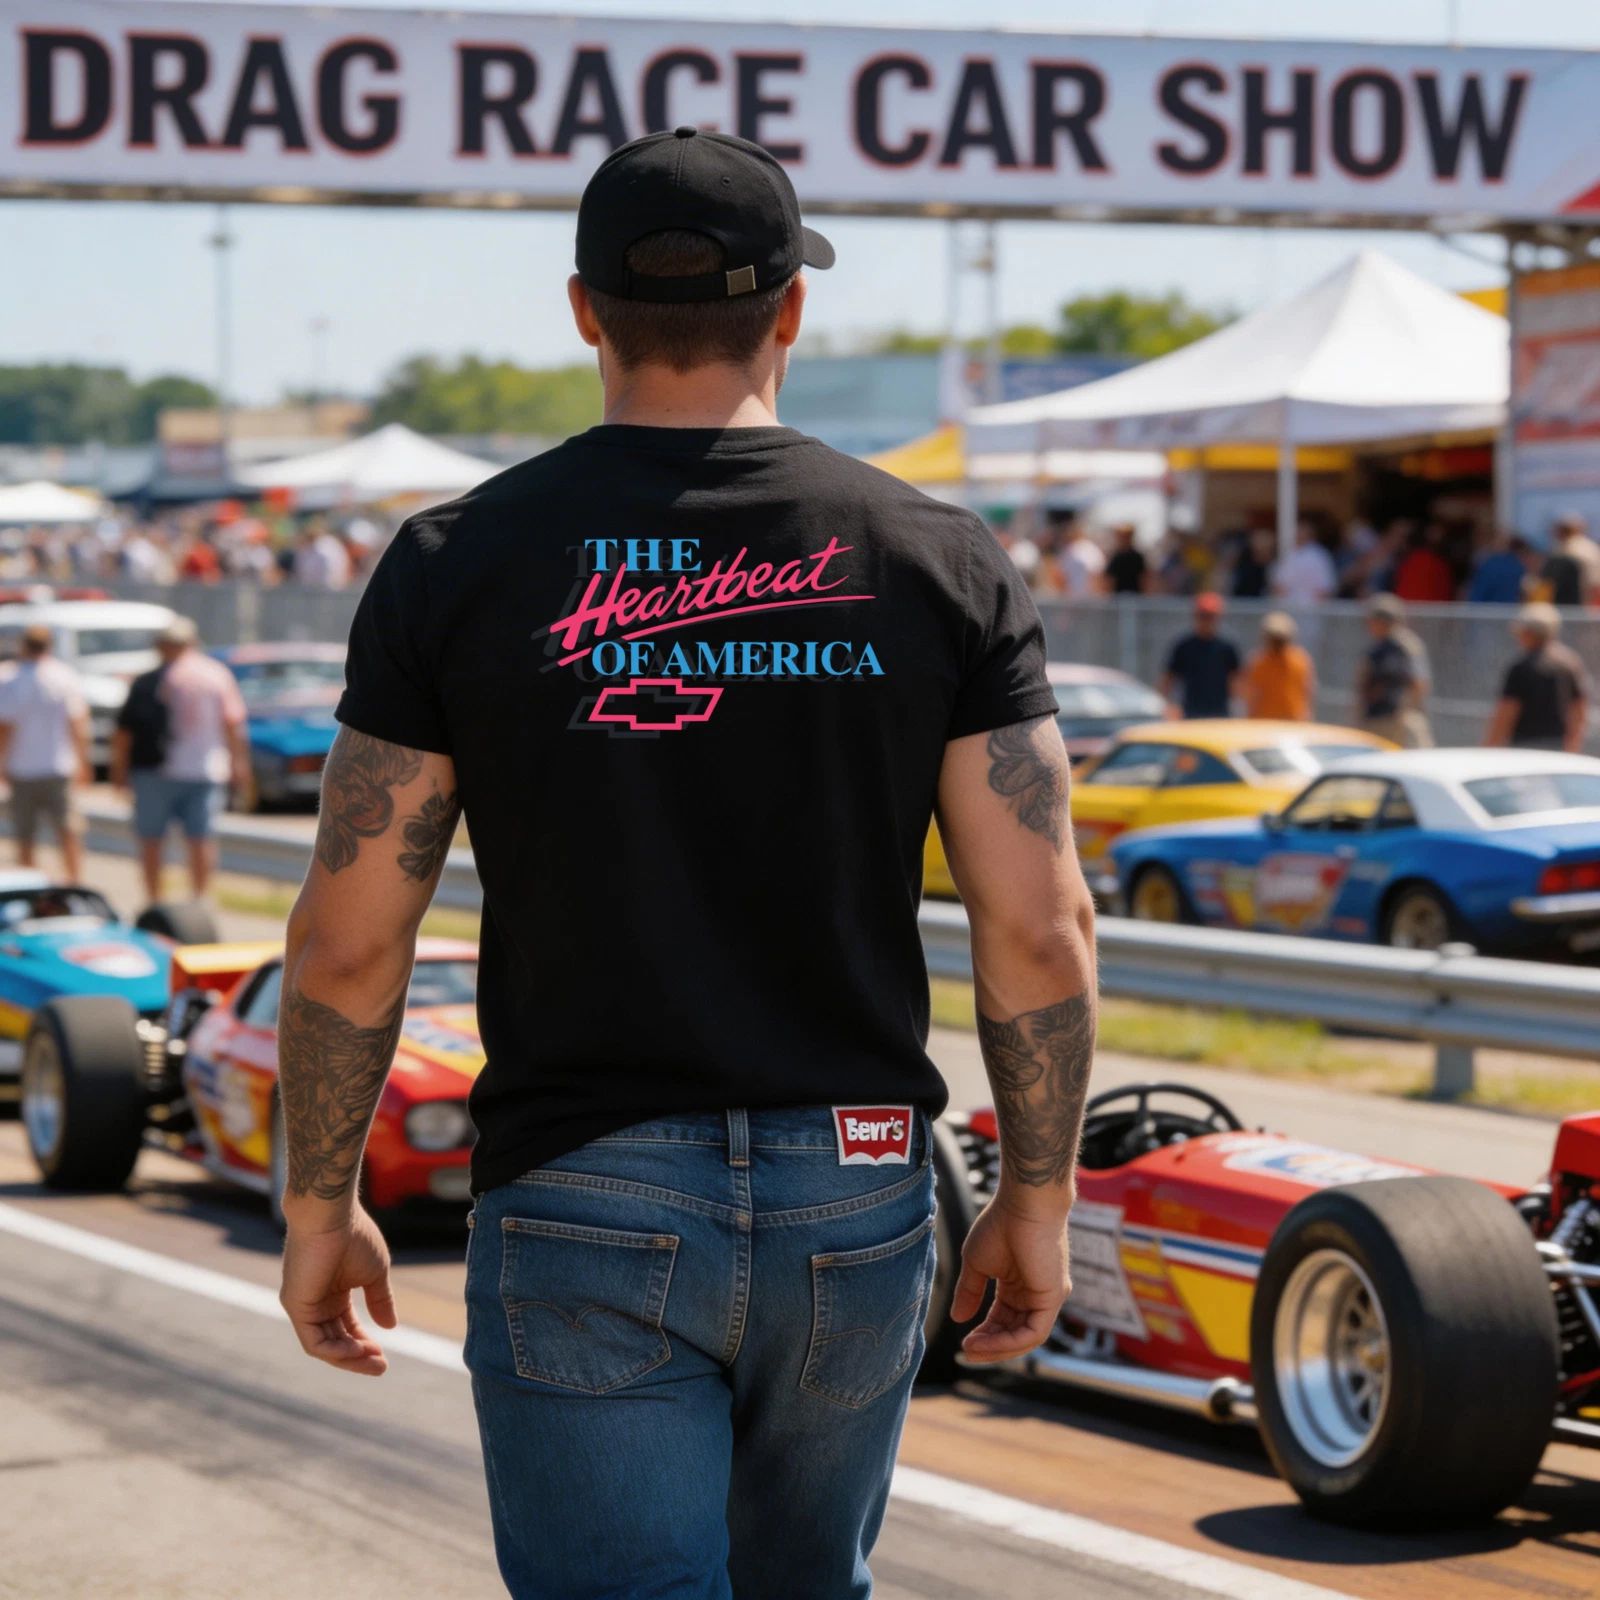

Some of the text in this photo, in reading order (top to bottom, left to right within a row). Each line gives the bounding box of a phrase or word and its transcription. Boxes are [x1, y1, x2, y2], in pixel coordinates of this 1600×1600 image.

[18, 27, 1531, 185] DRAG RACE CAR SHOW
[584, 538, 702, 572] THE
[549, 536, 854, 650] Heartbeat
[591, 640, 886, 676] OF AMERICA
